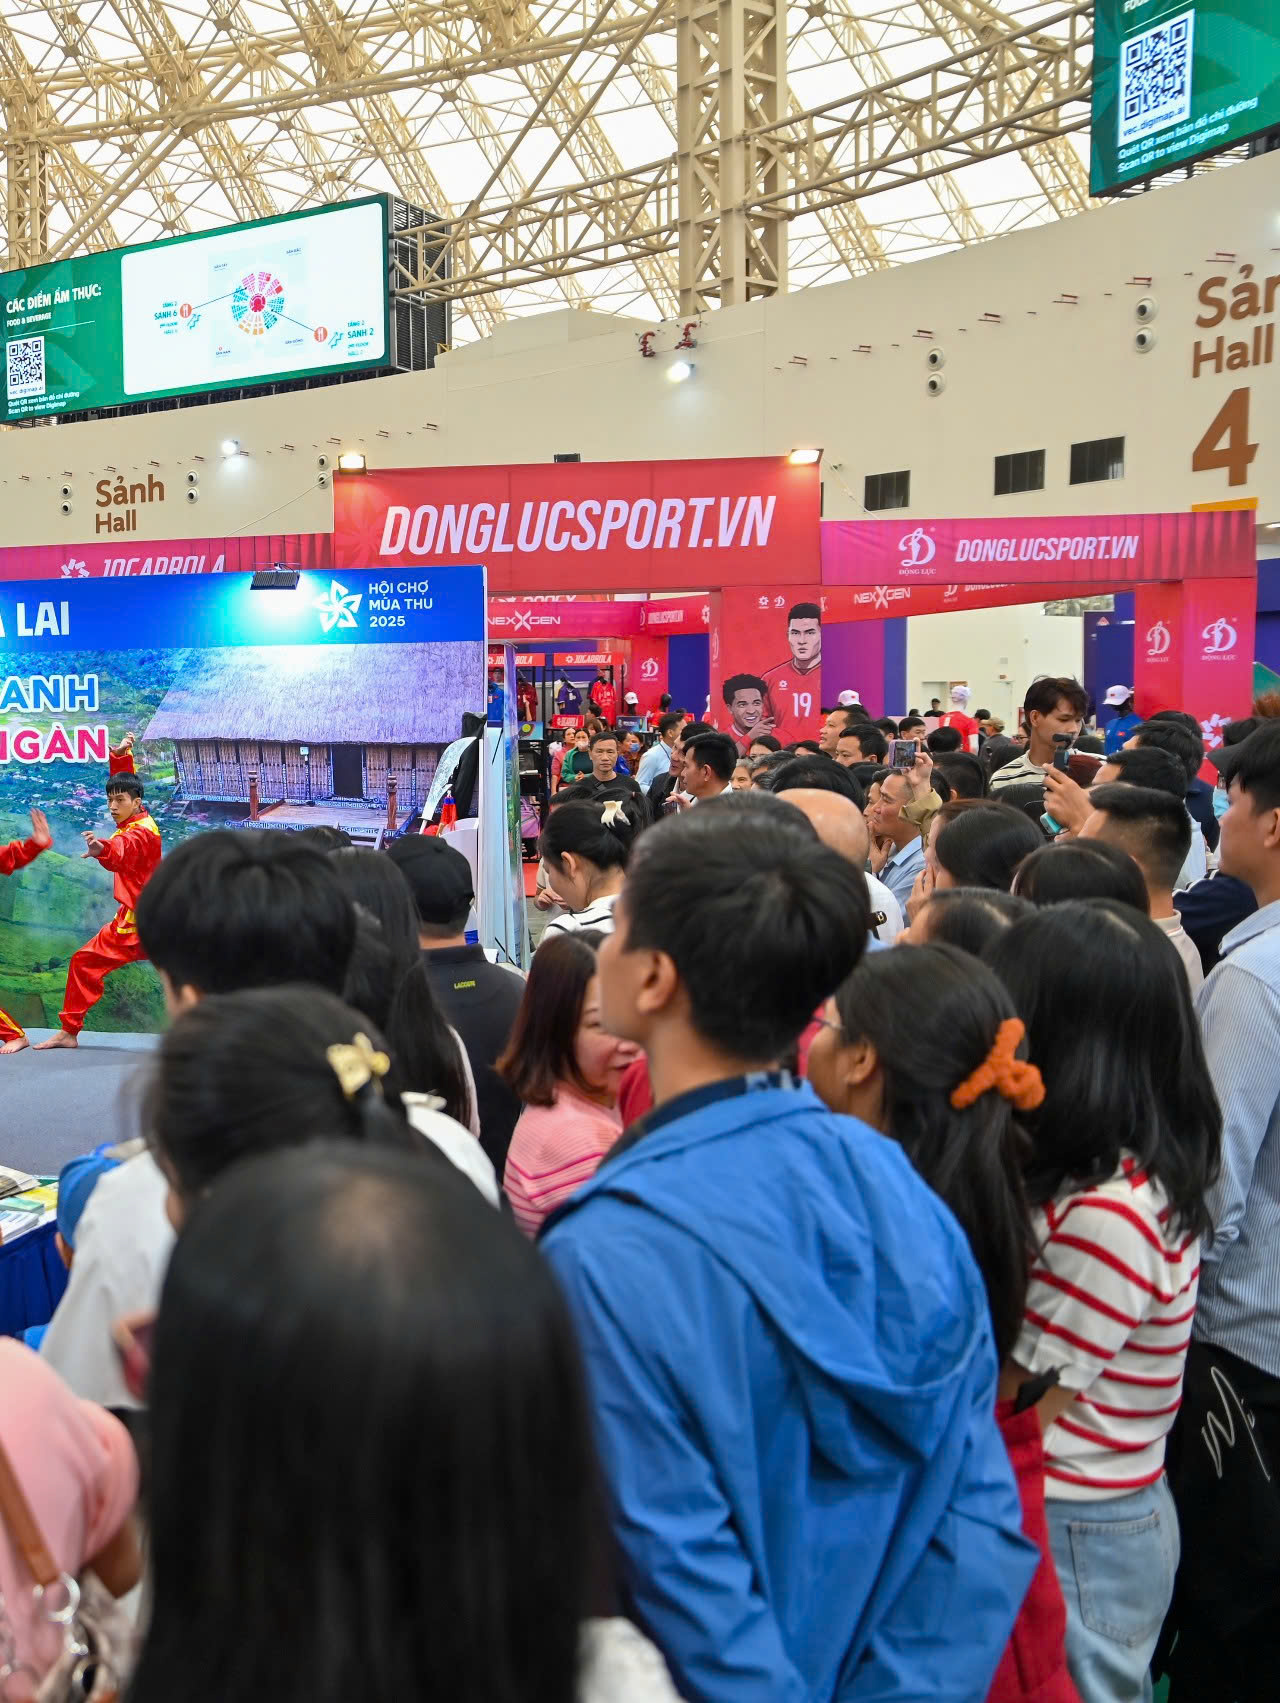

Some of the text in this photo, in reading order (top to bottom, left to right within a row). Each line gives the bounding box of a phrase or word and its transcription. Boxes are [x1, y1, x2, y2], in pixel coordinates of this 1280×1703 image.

[1123, 105, 1185, 136] vec.digimap.ai
[1118, 123, 1229, 173] Scan QR to view Digimap
[1140, 137, 1155, 151] QR
[1155, 131, 1175, 144] xem
[6, 298, 25, 314] CÁC
[27, 290, 51, 310] ĐIỂM
[6, 318, 21, 327] FOOD
[26, 312, 52, 324] BEVERAGE
[1192, 323, 1275, 378] Hall
[1192, 386, 1260, 487] 4
[95, 473, 165, 507] Sảnh
[95, 509, 137, 534] Hall
[379, 495, 777, 556] DONGLUCSPORT.VN
[955, 535, 1140, 563] DONGLUCSPORT.VN
[368, 579, 429, 596] HỘI CHỢ
[369, 596, 433, 611] MÙA THU
[16, 601, 70, 637] LAI
[369, 615, 406, 628] 2025
[792, 692, 812, 718] 19
